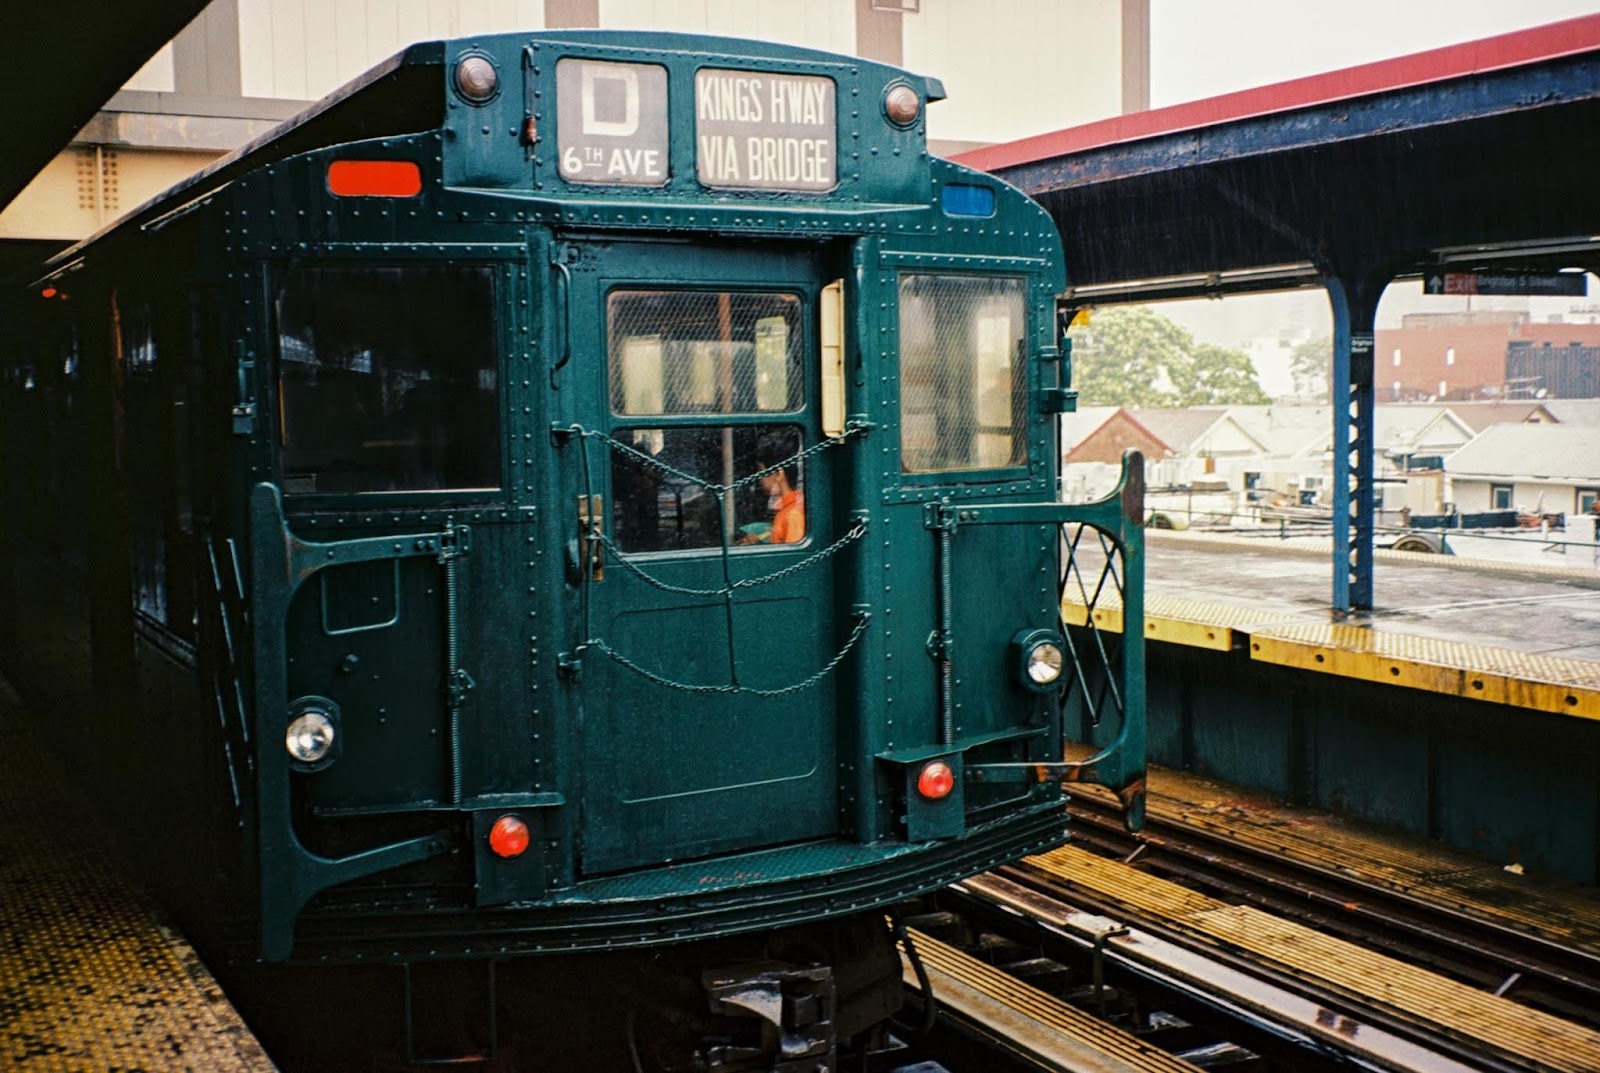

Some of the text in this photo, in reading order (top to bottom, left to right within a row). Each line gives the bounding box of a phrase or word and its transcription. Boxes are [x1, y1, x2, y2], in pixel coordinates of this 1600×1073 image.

[581, 63, 640, 137] D
[700, 76, 763, 123] KINGS
[607, 149, 661, 177] AVE
[700, 135, 830, 183] VIA BRIDGE
[1444, 274, 1477, 293] Exit
